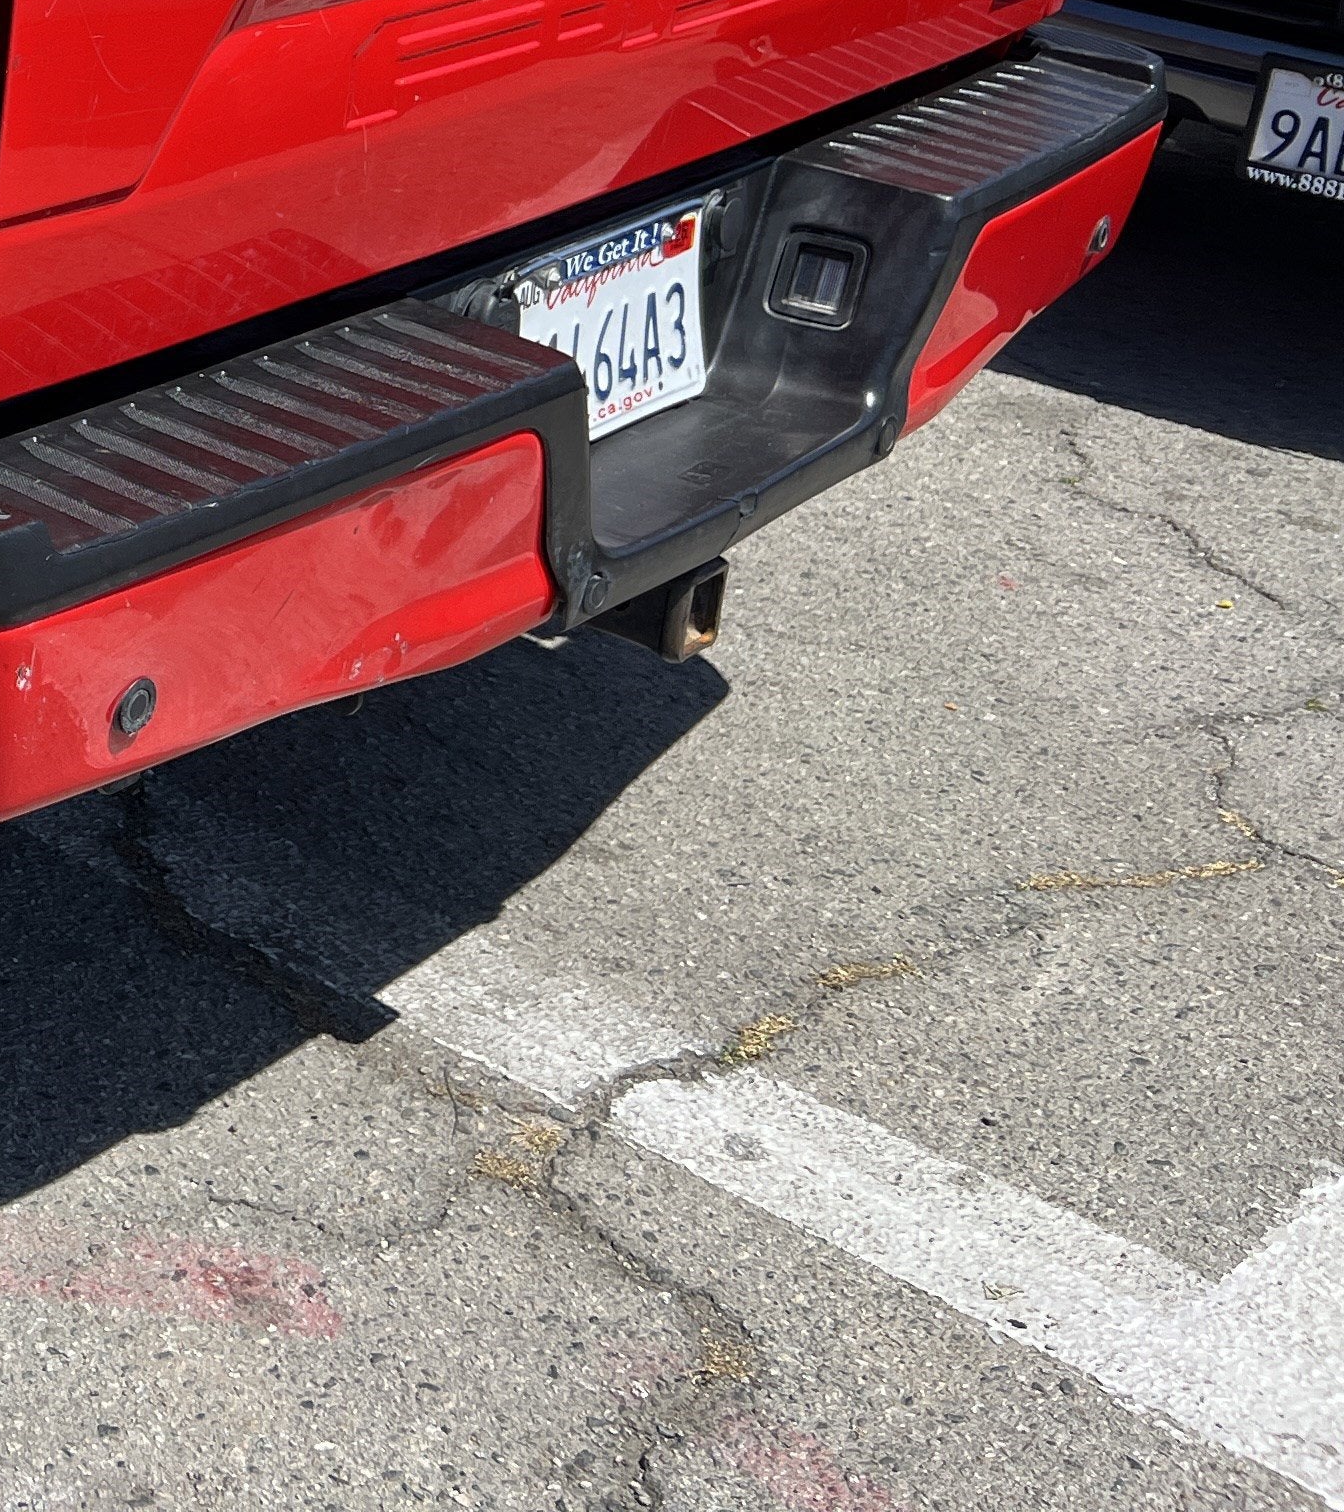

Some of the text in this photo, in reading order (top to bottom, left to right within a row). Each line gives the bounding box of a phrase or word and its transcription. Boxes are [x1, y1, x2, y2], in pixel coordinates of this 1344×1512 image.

[1263, 109, 1344, 175] 9A
[565, 251, 593, 279] We
[598, 238, 631, 267] Get
[547, 282, 686, 402] 64A3
[592, 384, 653, 422] .ca.gov
